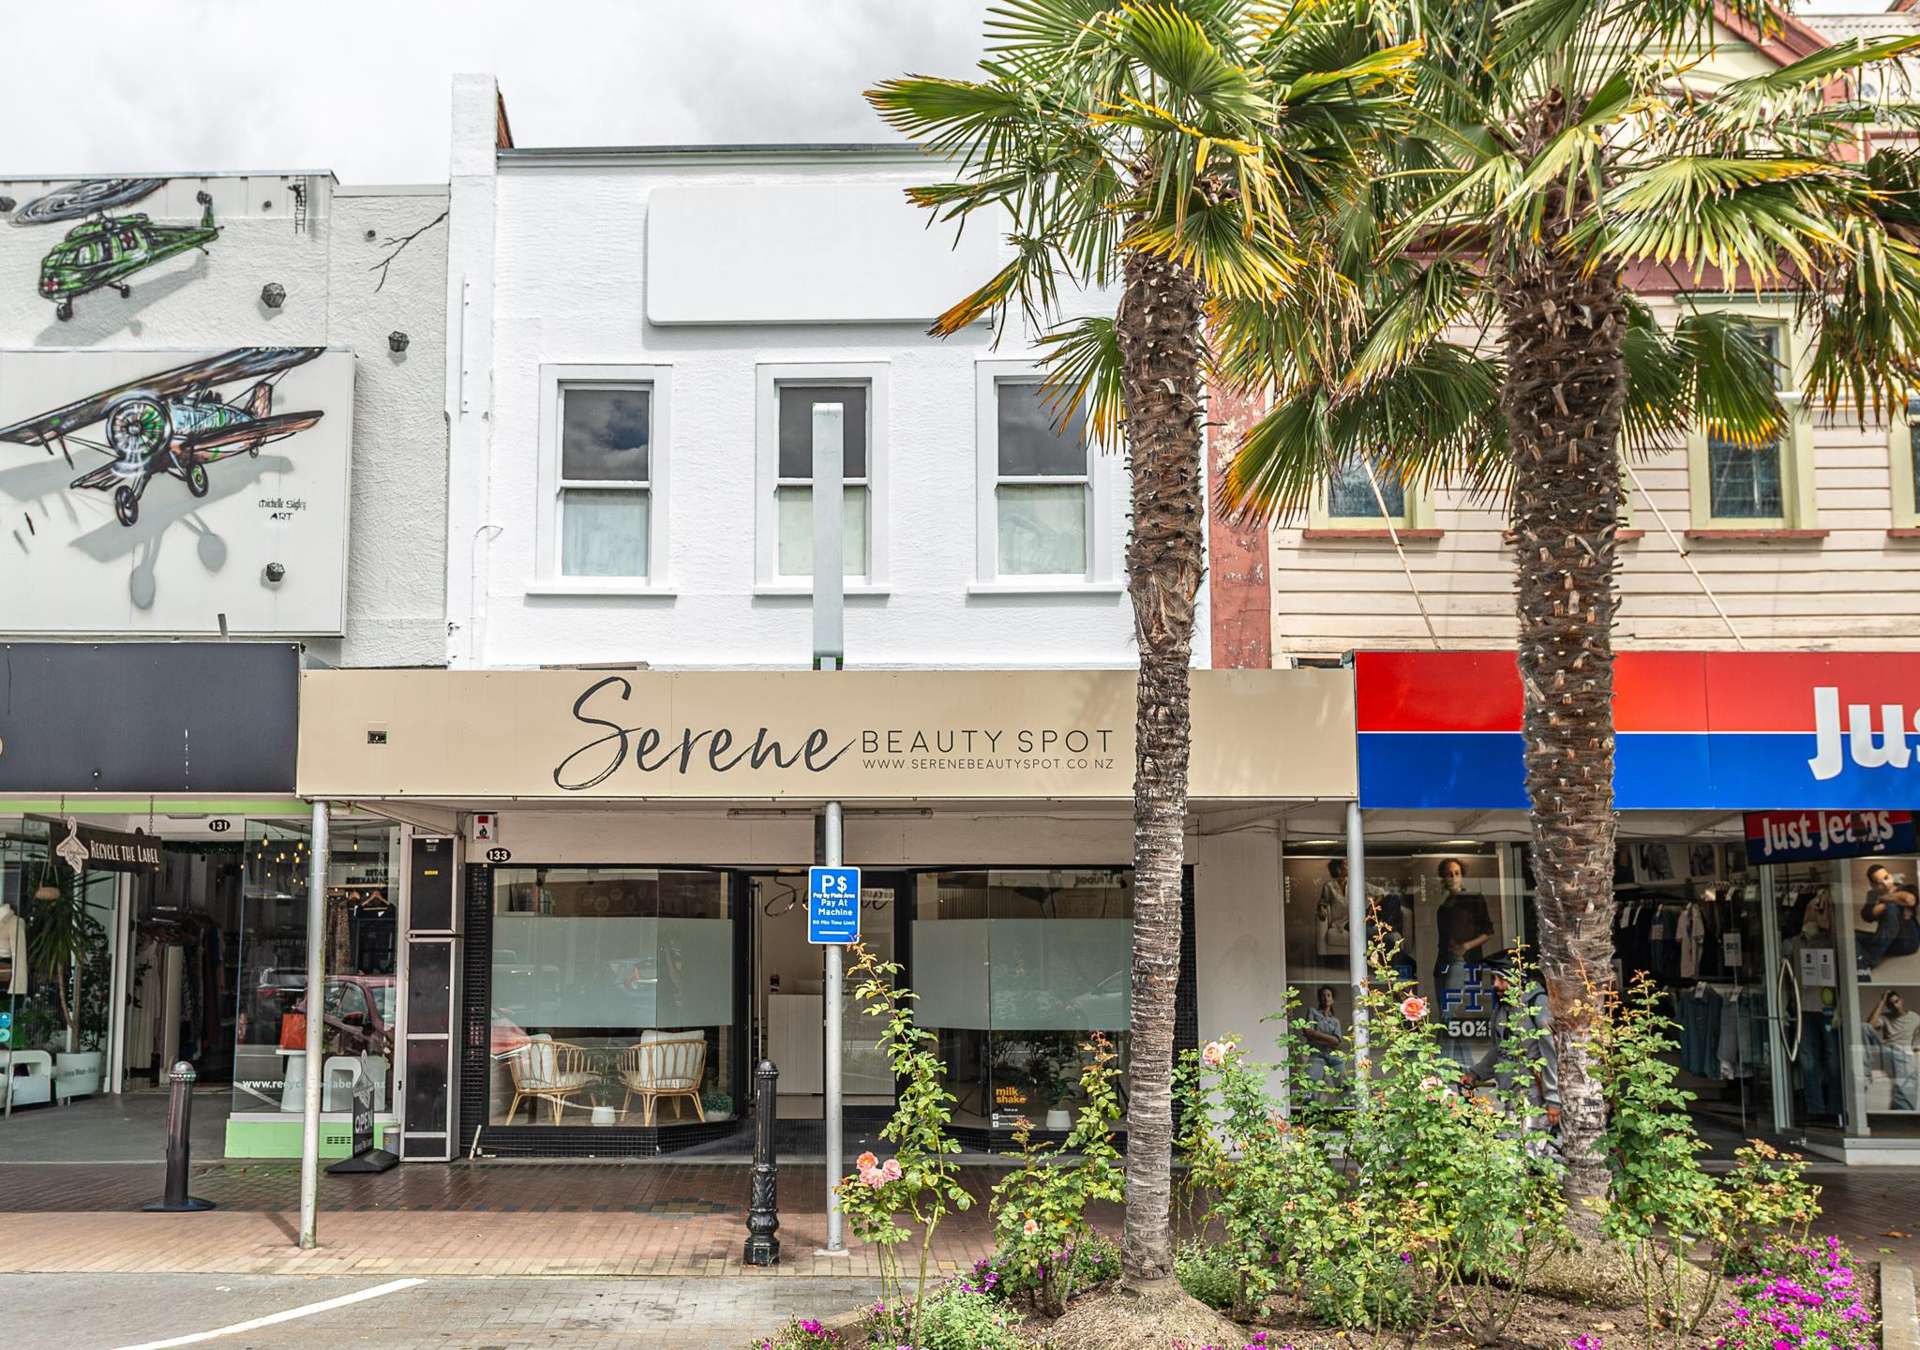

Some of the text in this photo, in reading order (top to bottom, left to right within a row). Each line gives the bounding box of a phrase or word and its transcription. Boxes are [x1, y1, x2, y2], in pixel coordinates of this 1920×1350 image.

[553, 675, 857, 790] Serene
[1807, 686, 1920, 781] Ju
[862, 730, 1113, 753] BEAUTY SPOT
[862, 759, 1114, 770] WWW.SERENEBEAUTYSPOT.CO.NZ
[211, 821, 229, 831] 131
[1762, 811, 1894, 856] Just Jeans
[489, 850, 508, 860] 133
[821, 899, 848, 907] Pay At
[818, 908, 853, 916] Machine
[1447, 1020, 1487, 1037] 50%
[996, 1087, 1018, 1096] milk
[996, 1096, 1027, 1104] shake
[355, 1111, 373, 1133] OPEN
